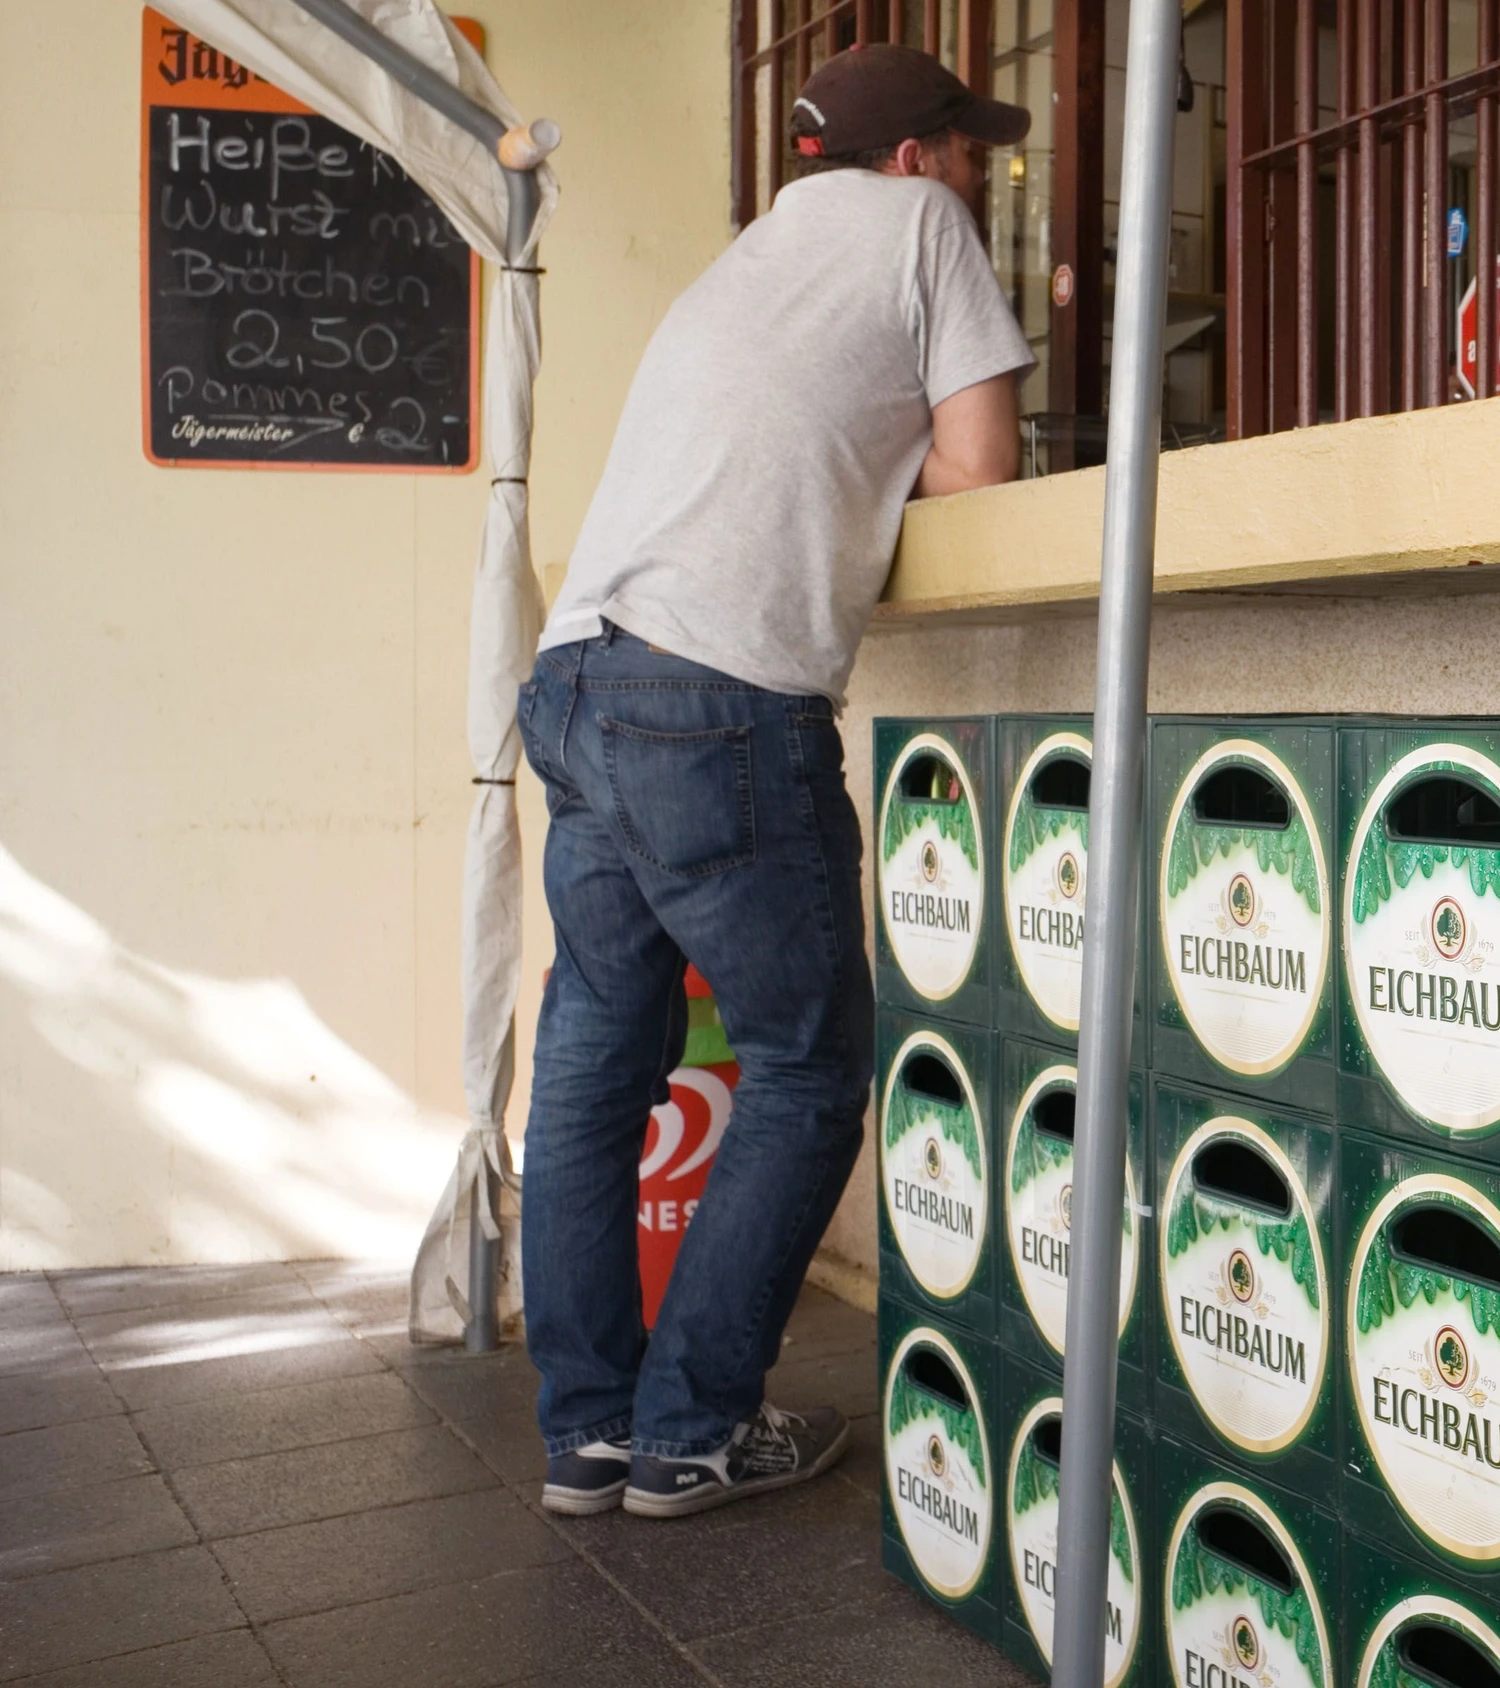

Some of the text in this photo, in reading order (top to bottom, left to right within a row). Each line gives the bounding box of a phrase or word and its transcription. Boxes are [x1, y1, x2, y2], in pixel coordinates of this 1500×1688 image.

[168, 113, 354, 199] Heiße
[160, 180, 349, 238] Wurst
[160, 248, 430, 307] Brötchen
[227, 310, 398, 374] 2,50
[159, 365, 372, 423] Pommes
[172, 415, 364, 447] Jägermeister €
[892, 890, 970, 934] EICHBAUM
[1019, 904, 1085, 950] EICHBA
[1404, 929, 1495, 953] SEIT 1679
[1180, 933, 1306, 994] EICHBAUM
[895, 1178, 974, 1240] EICHBAUM
[1181, 1295, 1306, 1384] EICHBAUM
[1408, 1349, 1498, 1392] SEIT 1679
[897, 1466, 978, 1546] EICHBAUM
